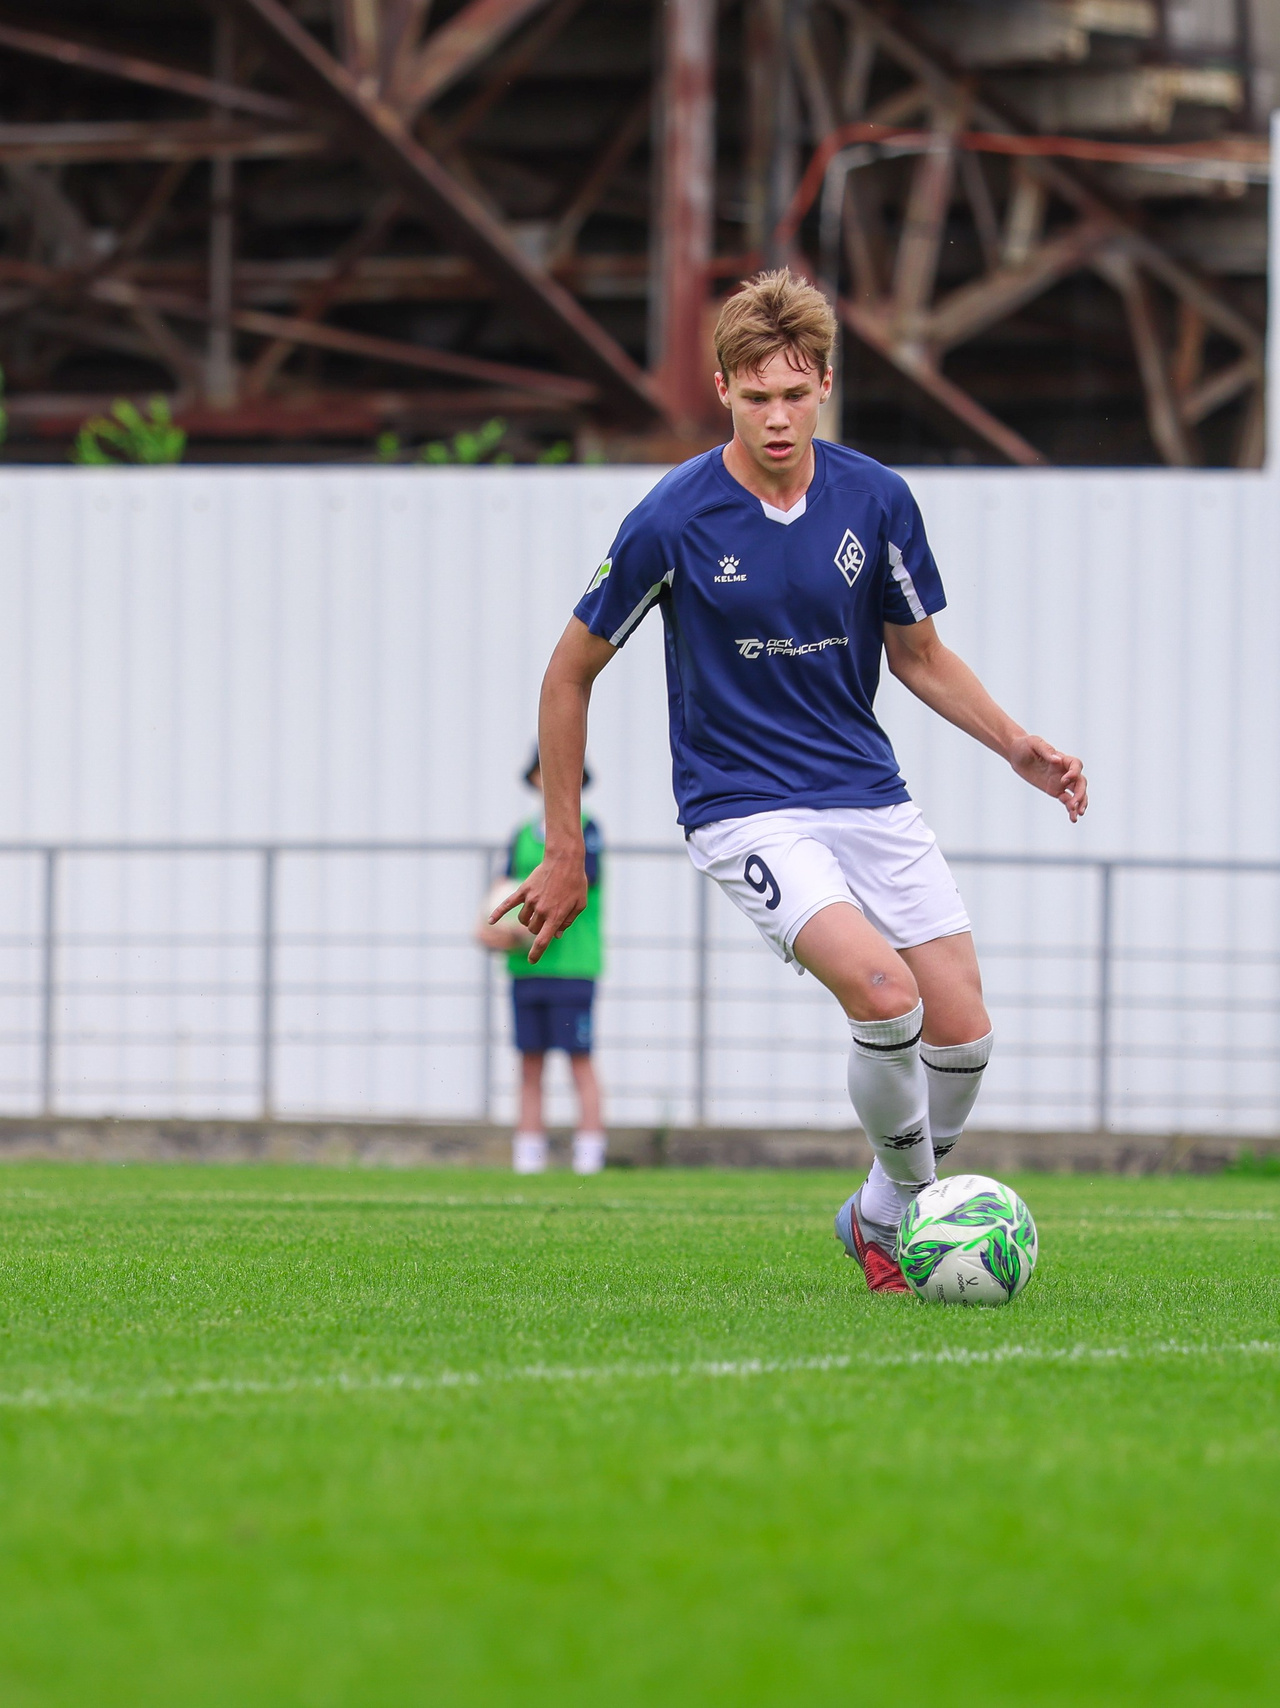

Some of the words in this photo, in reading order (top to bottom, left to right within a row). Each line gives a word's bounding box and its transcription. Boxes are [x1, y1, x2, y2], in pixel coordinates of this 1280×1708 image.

[714, 574, 747, 583] KELME
[766, 638, 794, 648] ДСК
[766, 636, 849, 657] ТРАНССТРОЙ
[744, 854, 781, 910] 9
